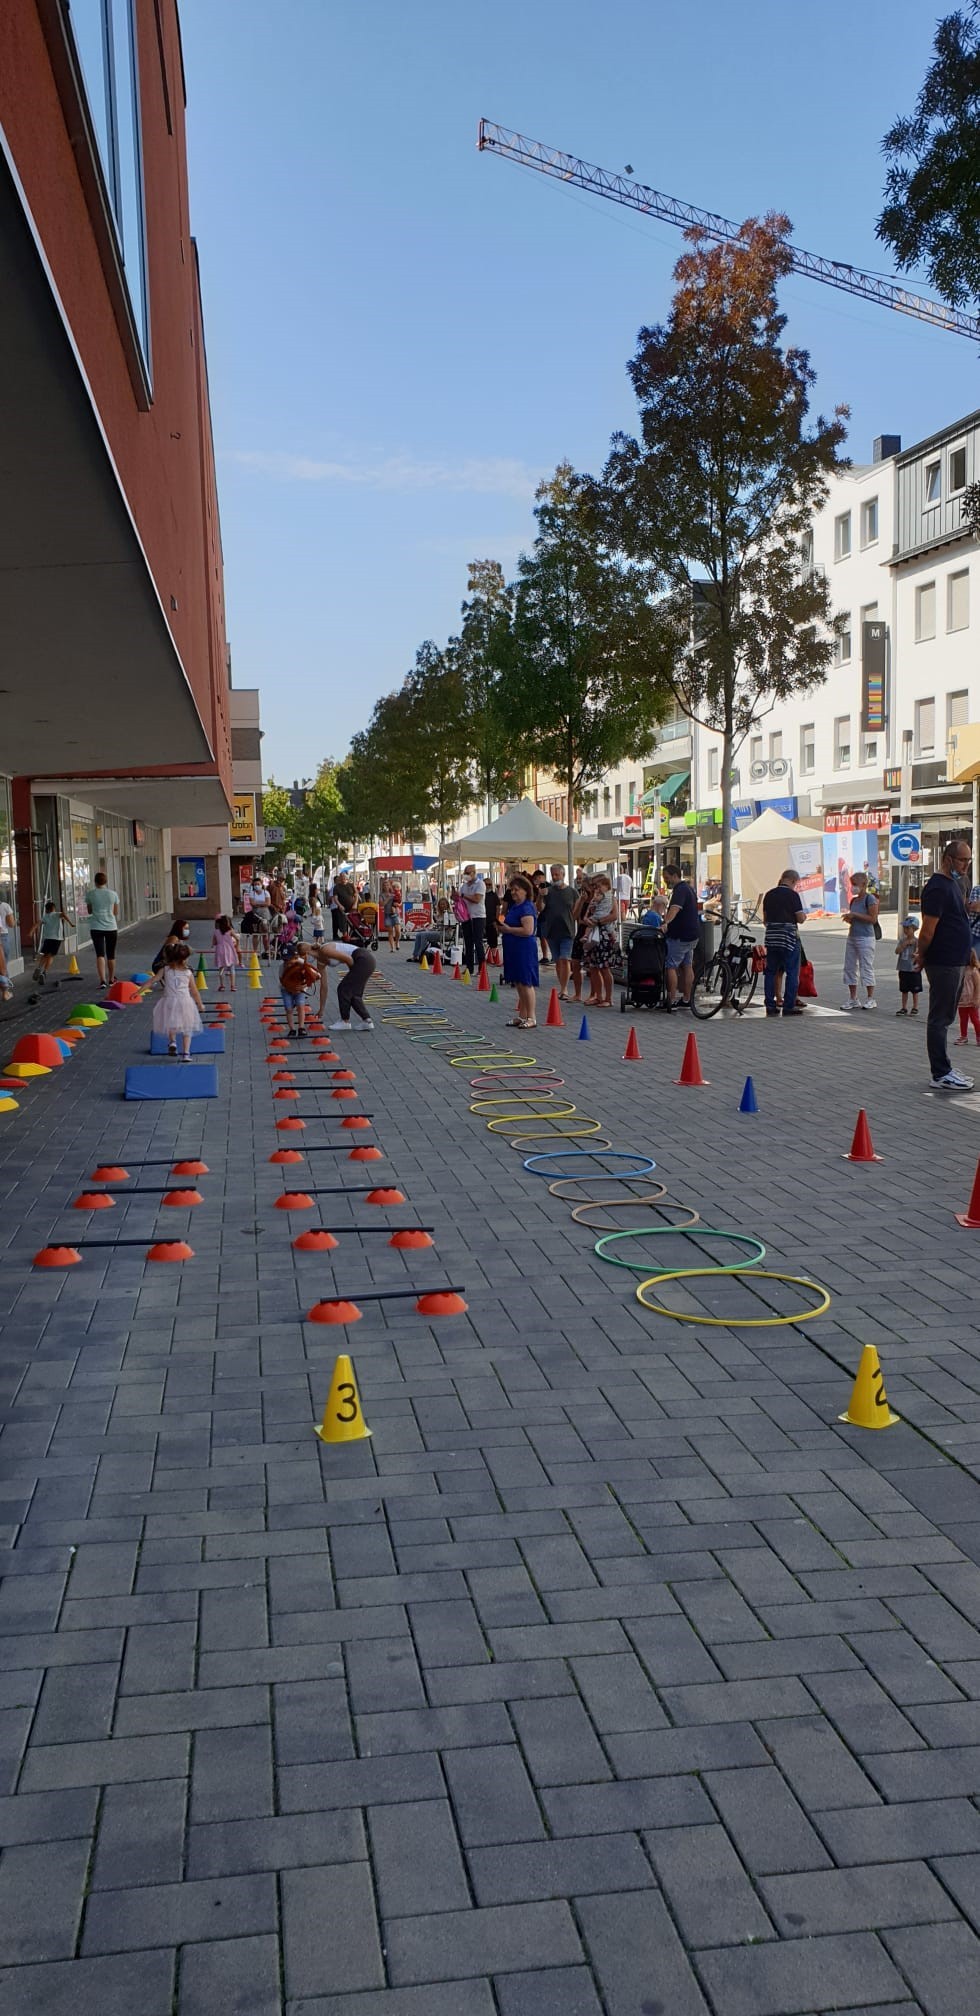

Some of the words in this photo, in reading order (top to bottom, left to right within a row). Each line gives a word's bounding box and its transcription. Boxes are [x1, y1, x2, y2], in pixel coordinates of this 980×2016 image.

[871, 628, 880, 638] M
[826, 814, 850, 827] OUTLET
[858, 811, 884, 824] OUTLET
[871, 1367, 888, 1407] 2
[336, 1382, 358, 1423] 3
